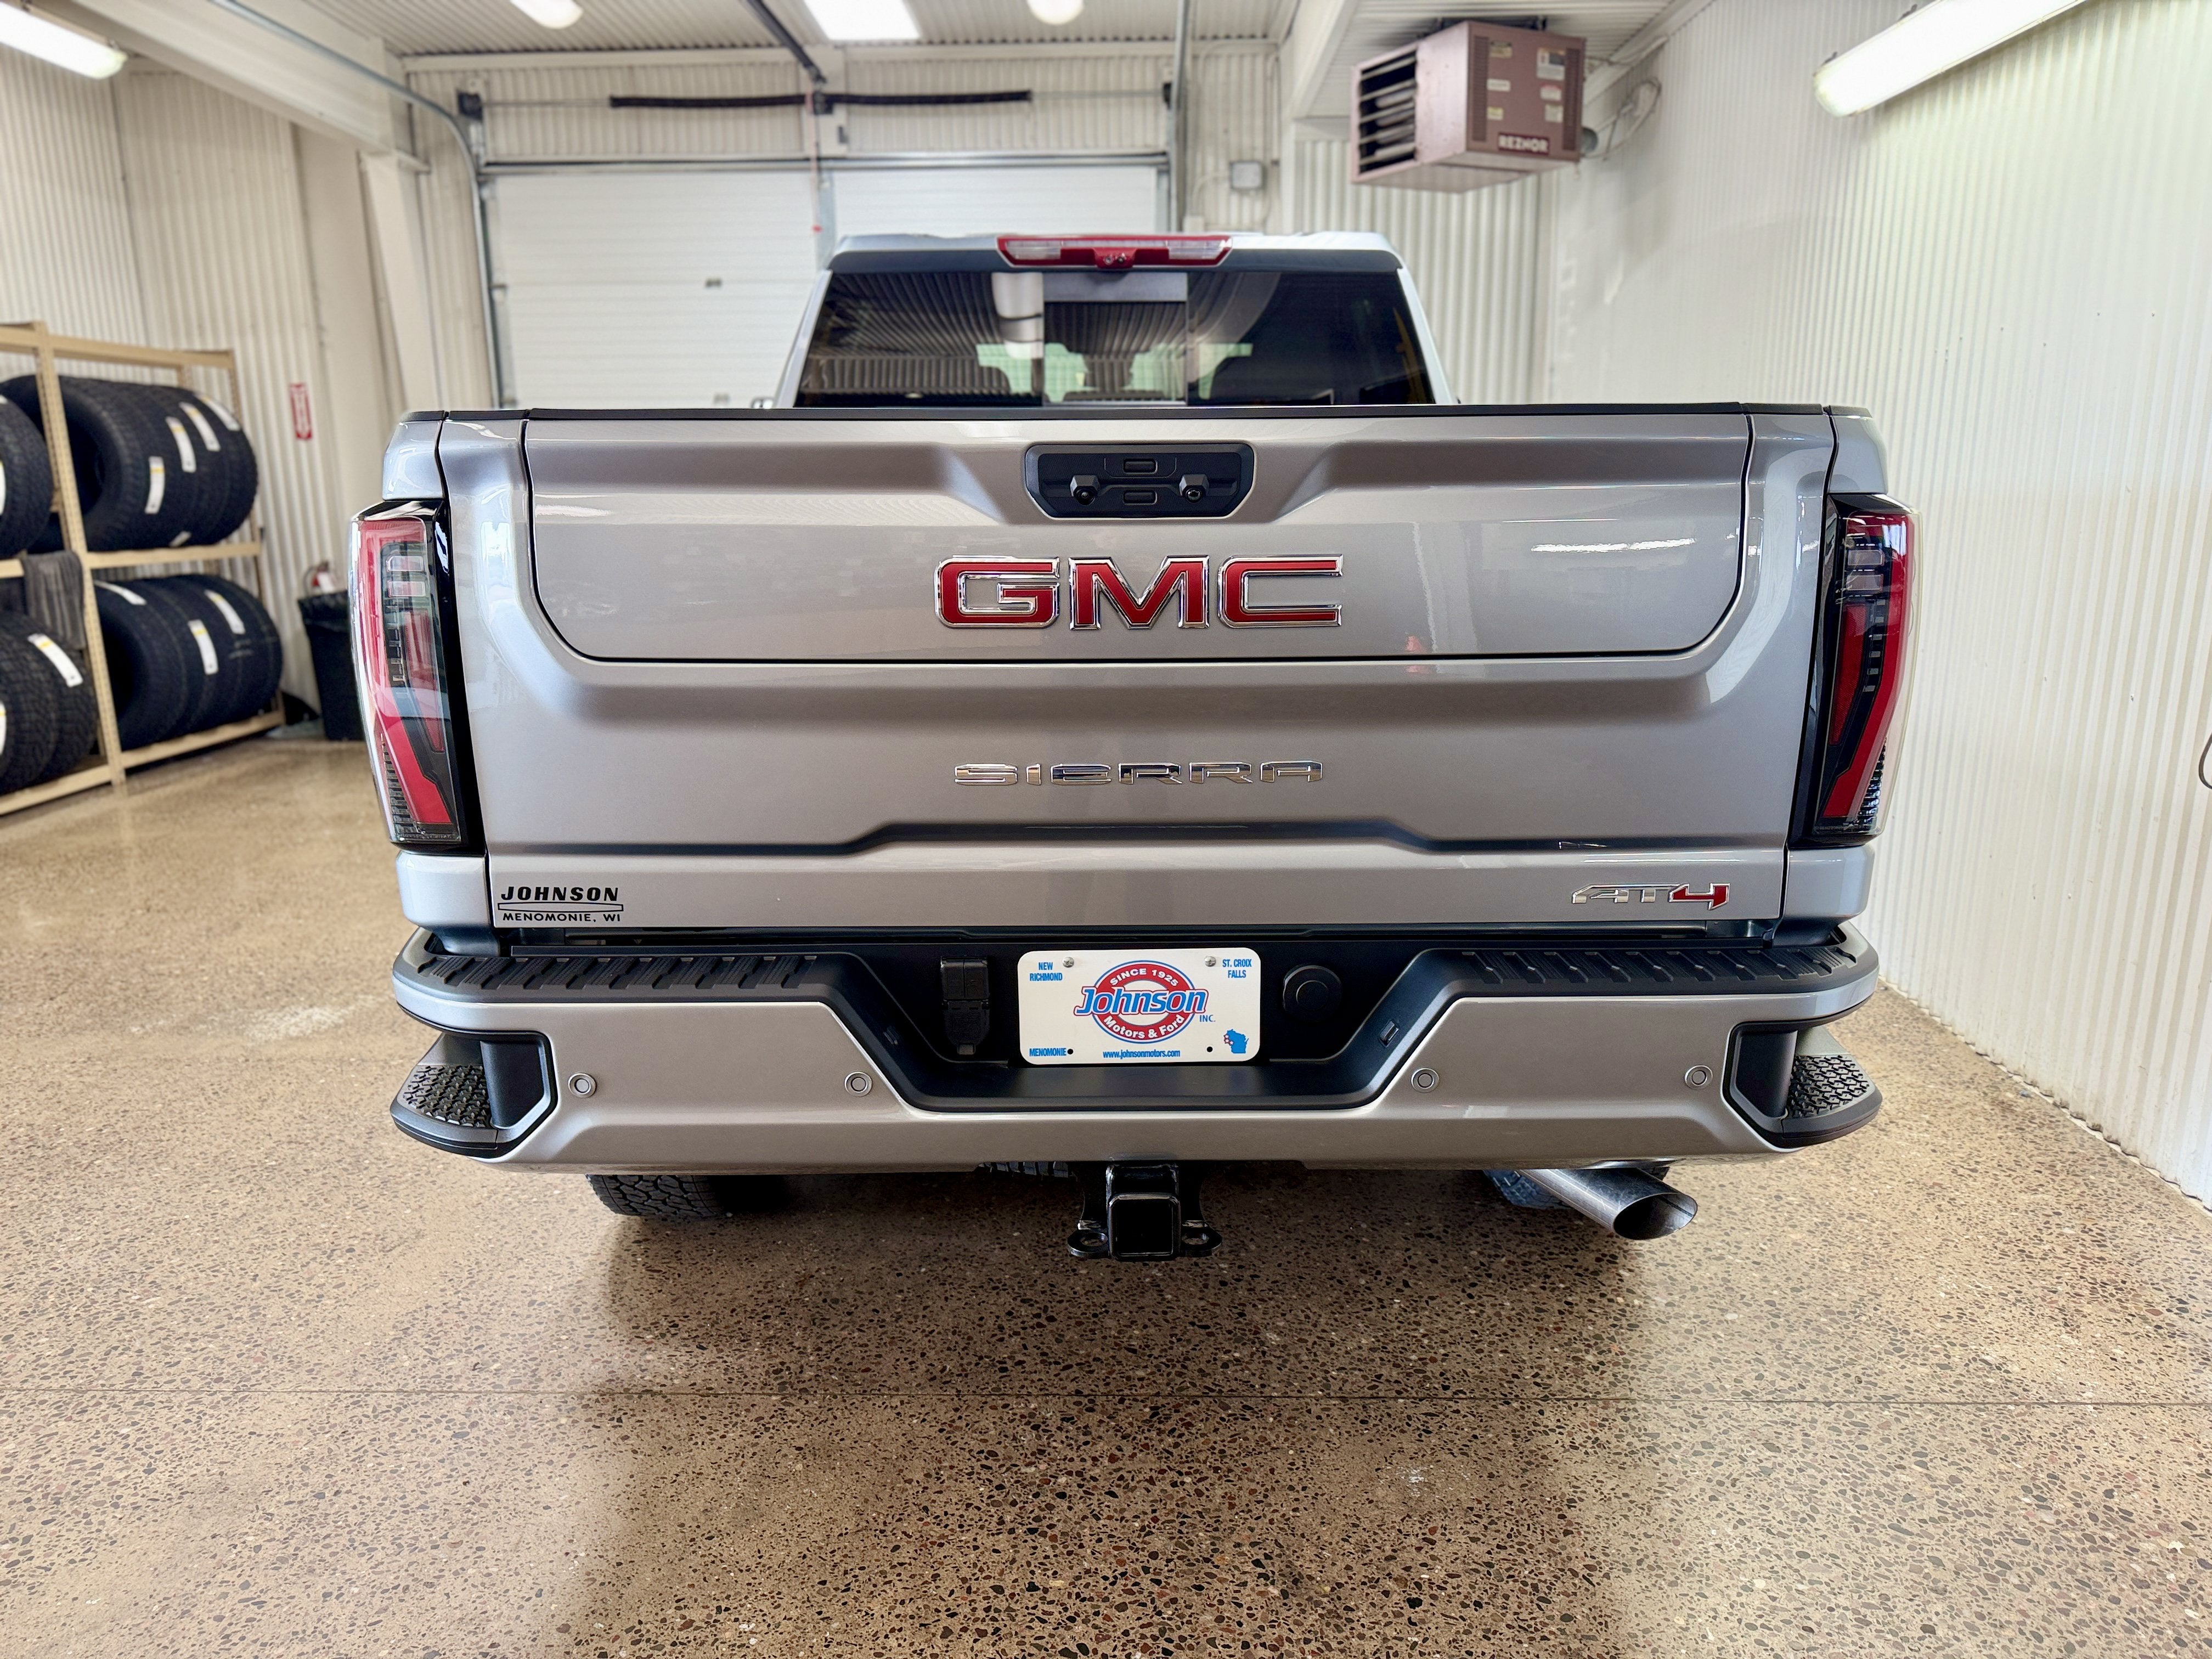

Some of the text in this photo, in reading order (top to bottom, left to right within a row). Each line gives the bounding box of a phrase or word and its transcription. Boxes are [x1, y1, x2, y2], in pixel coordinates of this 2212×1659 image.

[934, 554, 1343, 630] GMC
[955, 761, 1323, 785] SIERRA
[501, 886, 618, 901] JOHNSON
[1572, 883, 1730, 911] AT4
[503, 912, 620, 922] MENOMONIE, WI
[1039, 962, 1053, 970] NEW
[1222, 958, 1252, 967] ST. CROIX
[1029, 972, 1063, 981] RICHMOND
[1109, 968, 1179, 986] SINCE 1925
[1227, 969, 1246, 978] FALLS
[1075, 988, 1207, 1014] Johnson
[1103, 1014, 1185, 1039] Motors & Ford
[1029, 1047, 1067, 1057] MENOMONIE
[1102, 1049, 1181, 1059] www.johnsonmotors.com
